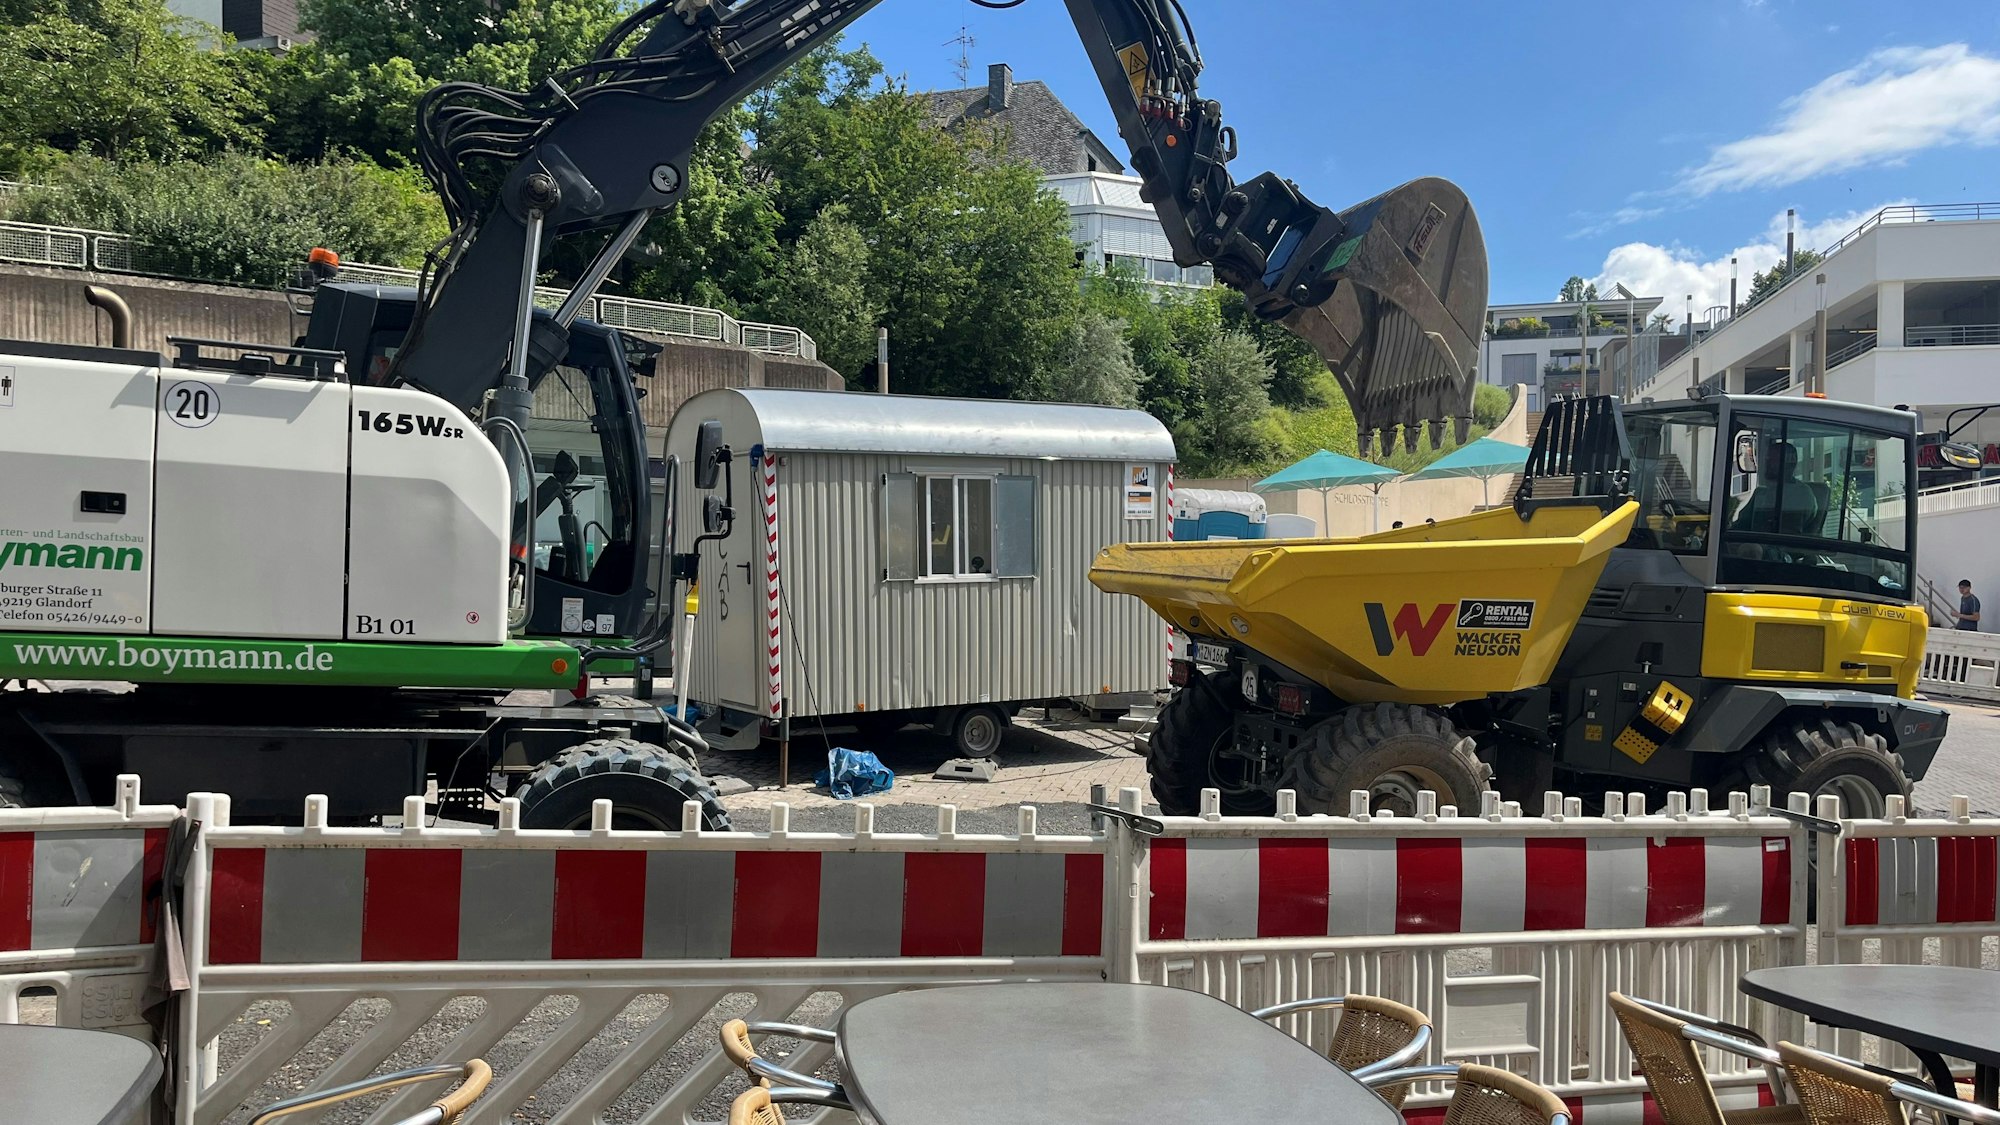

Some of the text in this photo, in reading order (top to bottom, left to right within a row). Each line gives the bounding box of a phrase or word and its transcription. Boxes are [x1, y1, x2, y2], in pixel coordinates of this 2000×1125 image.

[176, 388, 209, 420] 20
[1334, 492, 1389, 507] SCHLOSSTRPPE
[33, 530, 53, 538] und
[57, 530, 144, 543] Landschaftsbau
[46, 585, 88, 596] Straße
[92, 588, 102, 596] 11
[36, 597, 93, 609] Glandorf
[1486, 605, 1529, 616] RENTAL
[1842, 604, 1906, 620] dual view
[47, 612, 142, 624] 05426/9449-0
[356, 615, 384, 634] B1
[602, 624, 612, 632] 97
[1457, 633, 1521, 645] WACKER
[1454, 645, 1521, 656] NEUSON
[14, 640, 334, 675] www.boymann.de
[1246, 676, 1254, 697] 25
